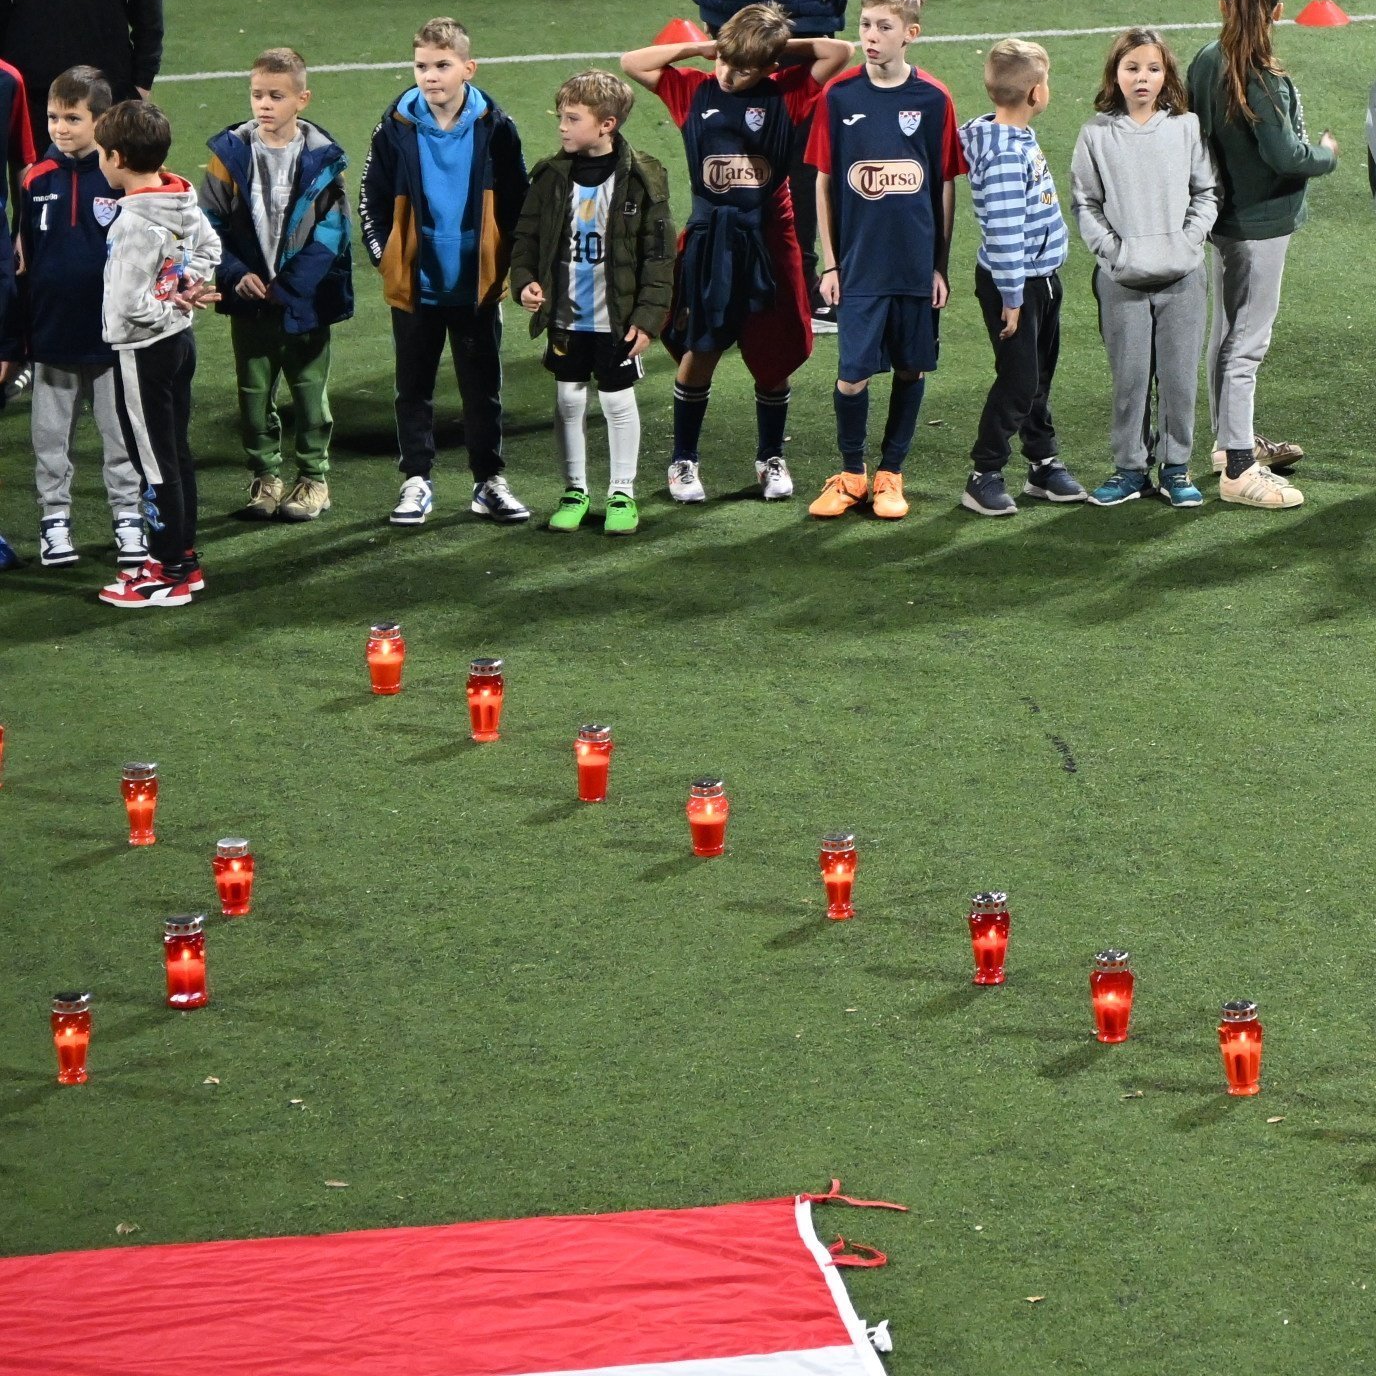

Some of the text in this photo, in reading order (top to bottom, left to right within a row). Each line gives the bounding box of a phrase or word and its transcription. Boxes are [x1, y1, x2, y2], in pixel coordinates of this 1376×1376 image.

[709, 159, 764, 190] Tarsa
[859, 165, 917, 196] Tarsa
[40, 204, 47, 230] 1
[370, 238, 382, 259] 1986
[572, 230, 605, 264] 10
